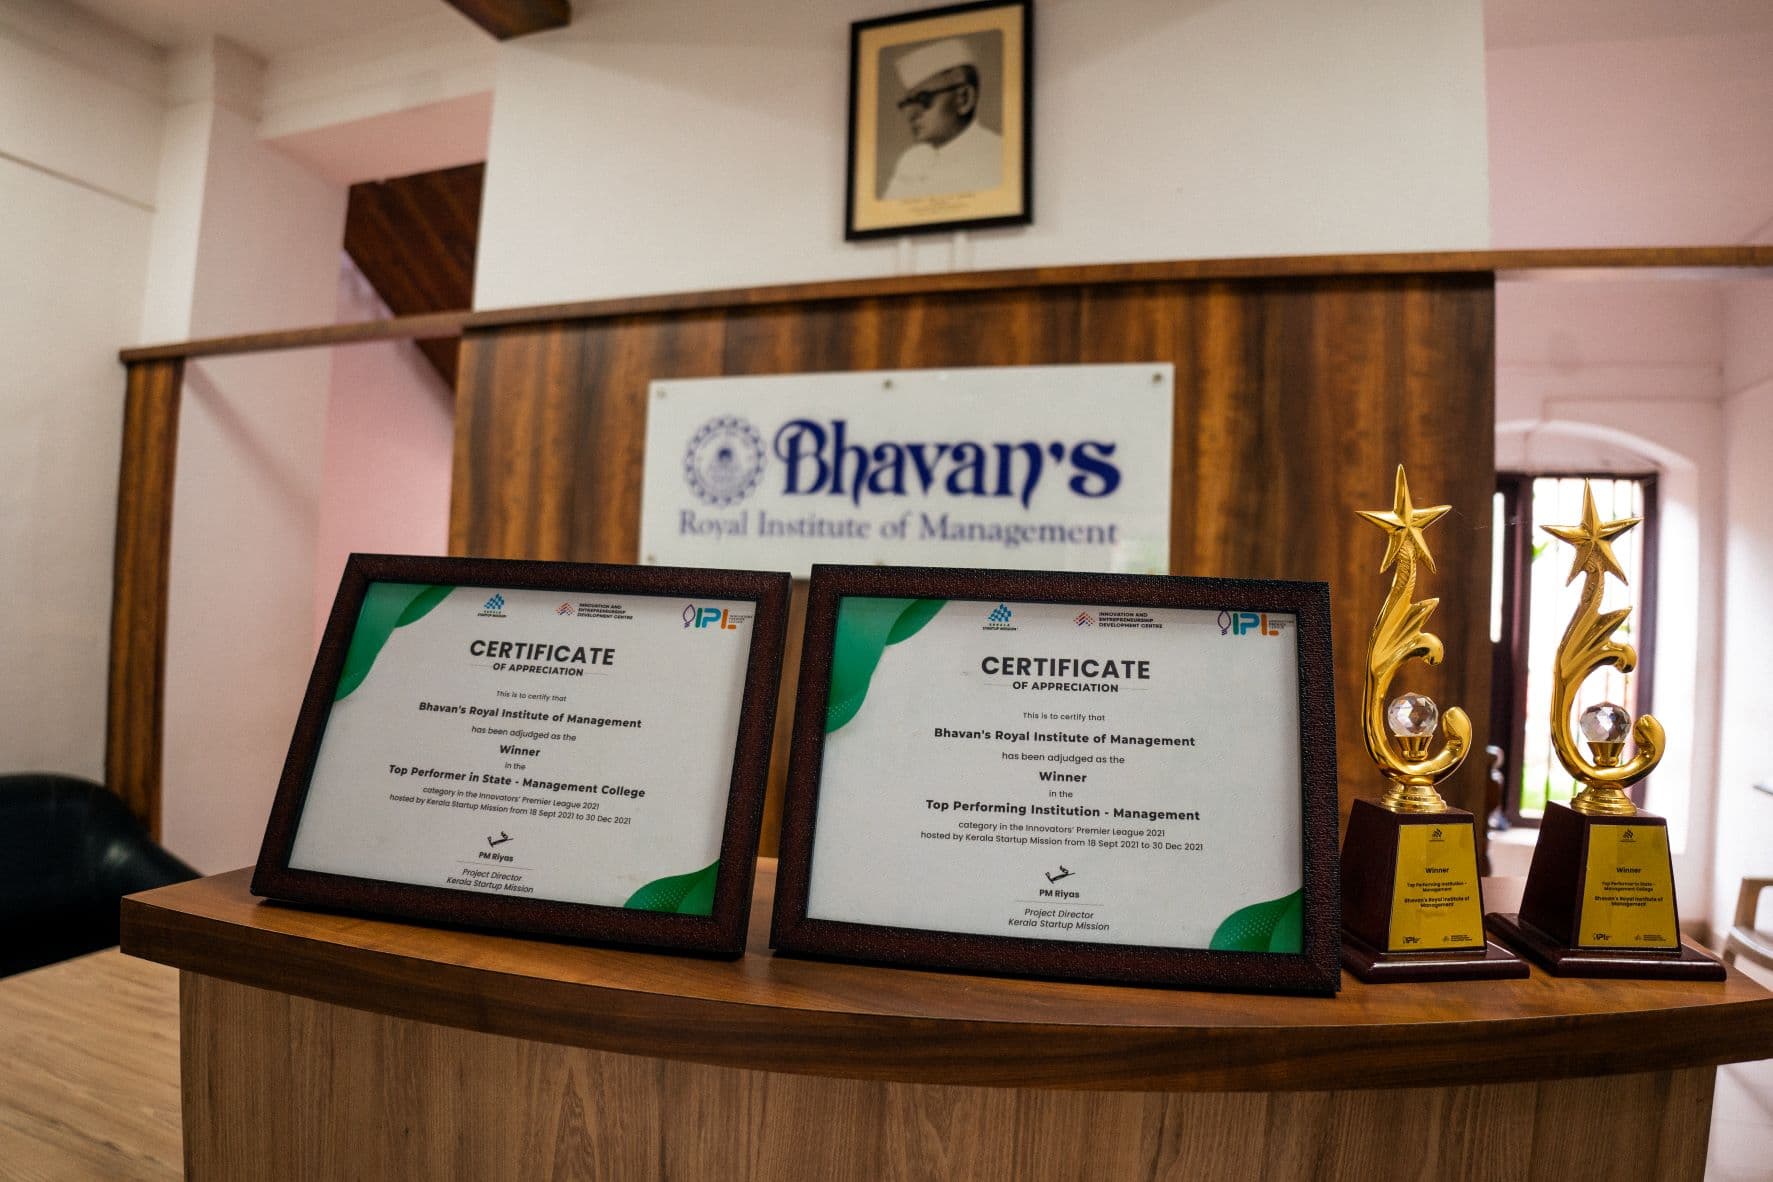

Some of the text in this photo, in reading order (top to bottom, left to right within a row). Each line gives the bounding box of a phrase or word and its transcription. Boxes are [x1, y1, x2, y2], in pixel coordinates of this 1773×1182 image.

[774, 418, 1122, 510] Bhavan's
[679, 511, 1118, 548] Royal Institute of Management
[469, 639, 615, 665] CERTIFICATE
[492, 662, 583, 676] OF APPRECIATION
[981, 656, 1150, 679] CERTIFICATE
[1012, 681, 1118, 692] OF APPRECIATION
[496, 688, 510, 697] This
[527, 693, 550, 702] certify
[418, 701, 641, 728] Bhavan's Royal Institute of Management
[1060, 713, 1086, 722] certify
[471, 725, 486, 733] has
[487, 727, 508, 735] been
[509, 729, 549, 740] adjudged
[562, 733, 576, 741] the
[934, 727, 1195, 747] Bhavan's Royal Institute of Management
[499, 744, 540, 756] Winner
[1001, 751, 1019, 760] has
[1021, 752, 1044, 760] been
[1047, 753, 1093, 764] adjudged
[1109, 755, 1125, 763] the
[389, 764, 408, 776] Top
[410, 766, 466, 780] Performer
[468, 771, 479, 782] in
[482, 774, 511, 785] State
[522, 777, 597, 793] Management
[601, 785, 645, 798] College
[1039, 770, 1087, 782] Winner
[422, 786, 456, 797] category
[456, 789, 464, 797] in
[465, 790, 478, 798] the
[521, 796, 551, 805] Premier
[552, 799, 581, 809] League
[582, 801, 599, 810] 2021
[388, 793, 415, 803] hosted
[415, 796, 426, 805] by
[425, 797, 450, 806] Kerala
[451, 799, 479, 811] Startup
[479, 803, 508, 812] Mission
[509, 805, 528, 814] from
[538, 809, 556, 818] Sept
[557, 810, 574, 819] 2021
[585, 813, 595, 821] 30
[596, 815, 612, 823] Dec
[613, 816, 631, 824] 2021
[925, 799, 949, 812] Top
[953, 800, 1026, 816] Performing
[1031, 804, 1100, 816] Institution
[1113, 807, 1200, 821] Management
[958, 821, 997, 831] category
[1076, 826, 1110, 834] Premier
[1112, 828, 1144, 838] League
[1146, 828, 1164, 837] 2021
[920, 831, 950, 839] hosted
[952, 832, 964, 842] by
[965, 833, 993, 841] Kerala
[995, 835, 1027, 845] Startup
[1029, 836, 1062, 845] Mission
[1064, 837, 1085, 846] from
[1087, 838, 1096, 846] 18
[1098, 839, 1118, 849] Sept
[1120, 840, 1138, 848] 2021
[1152, 841, 1162, 849] 30
[1165, 842, 1182, 850] Dec
[1184, 842, 1203, 851] 2021
[478, 851, 513, 862] PM Riyas
[461, 868, 522, 882] Project Director
[446, 877, 533, 893] Kerala Startup Mission
[1054, 889, 1079, 899] Riyas
[1024, 908, 1094, 920] Project Director
[1008, 917, 1109, 931] Kerala Startup Mission
